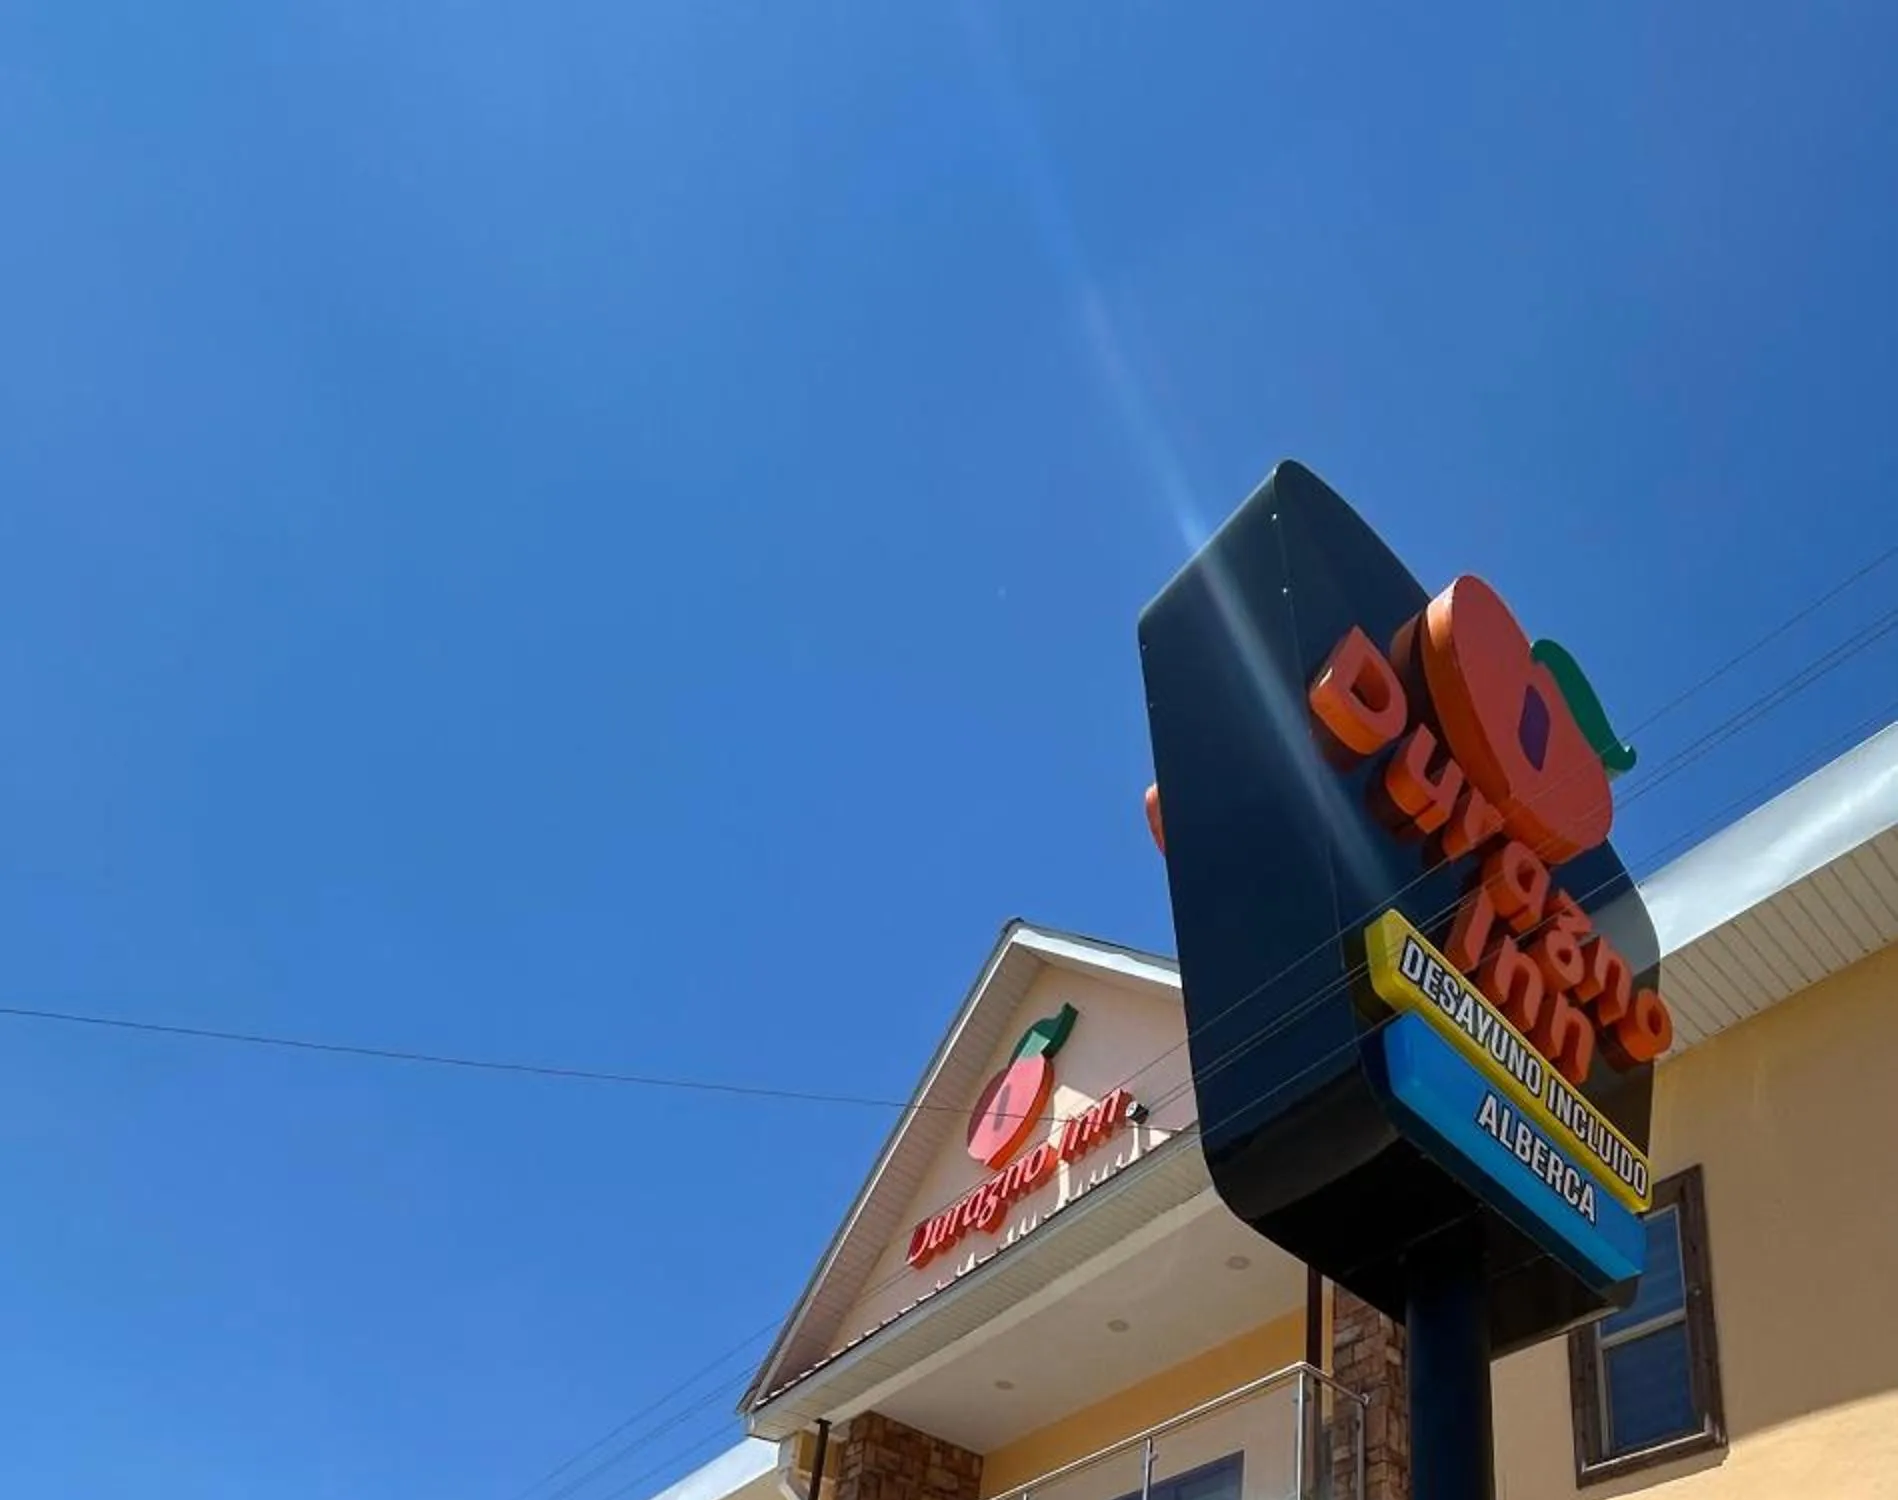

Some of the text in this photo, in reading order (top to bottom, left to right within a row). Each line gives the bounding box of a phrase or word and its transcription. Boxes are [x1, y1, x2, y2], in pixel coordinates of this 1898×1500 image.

[1400, 936, 1650, 1198] DESAYUNO INCLUIDO
[1445, 886, 1596, 1086] Inn
[1475, 1090, 1597, 1225] ALBERCA
